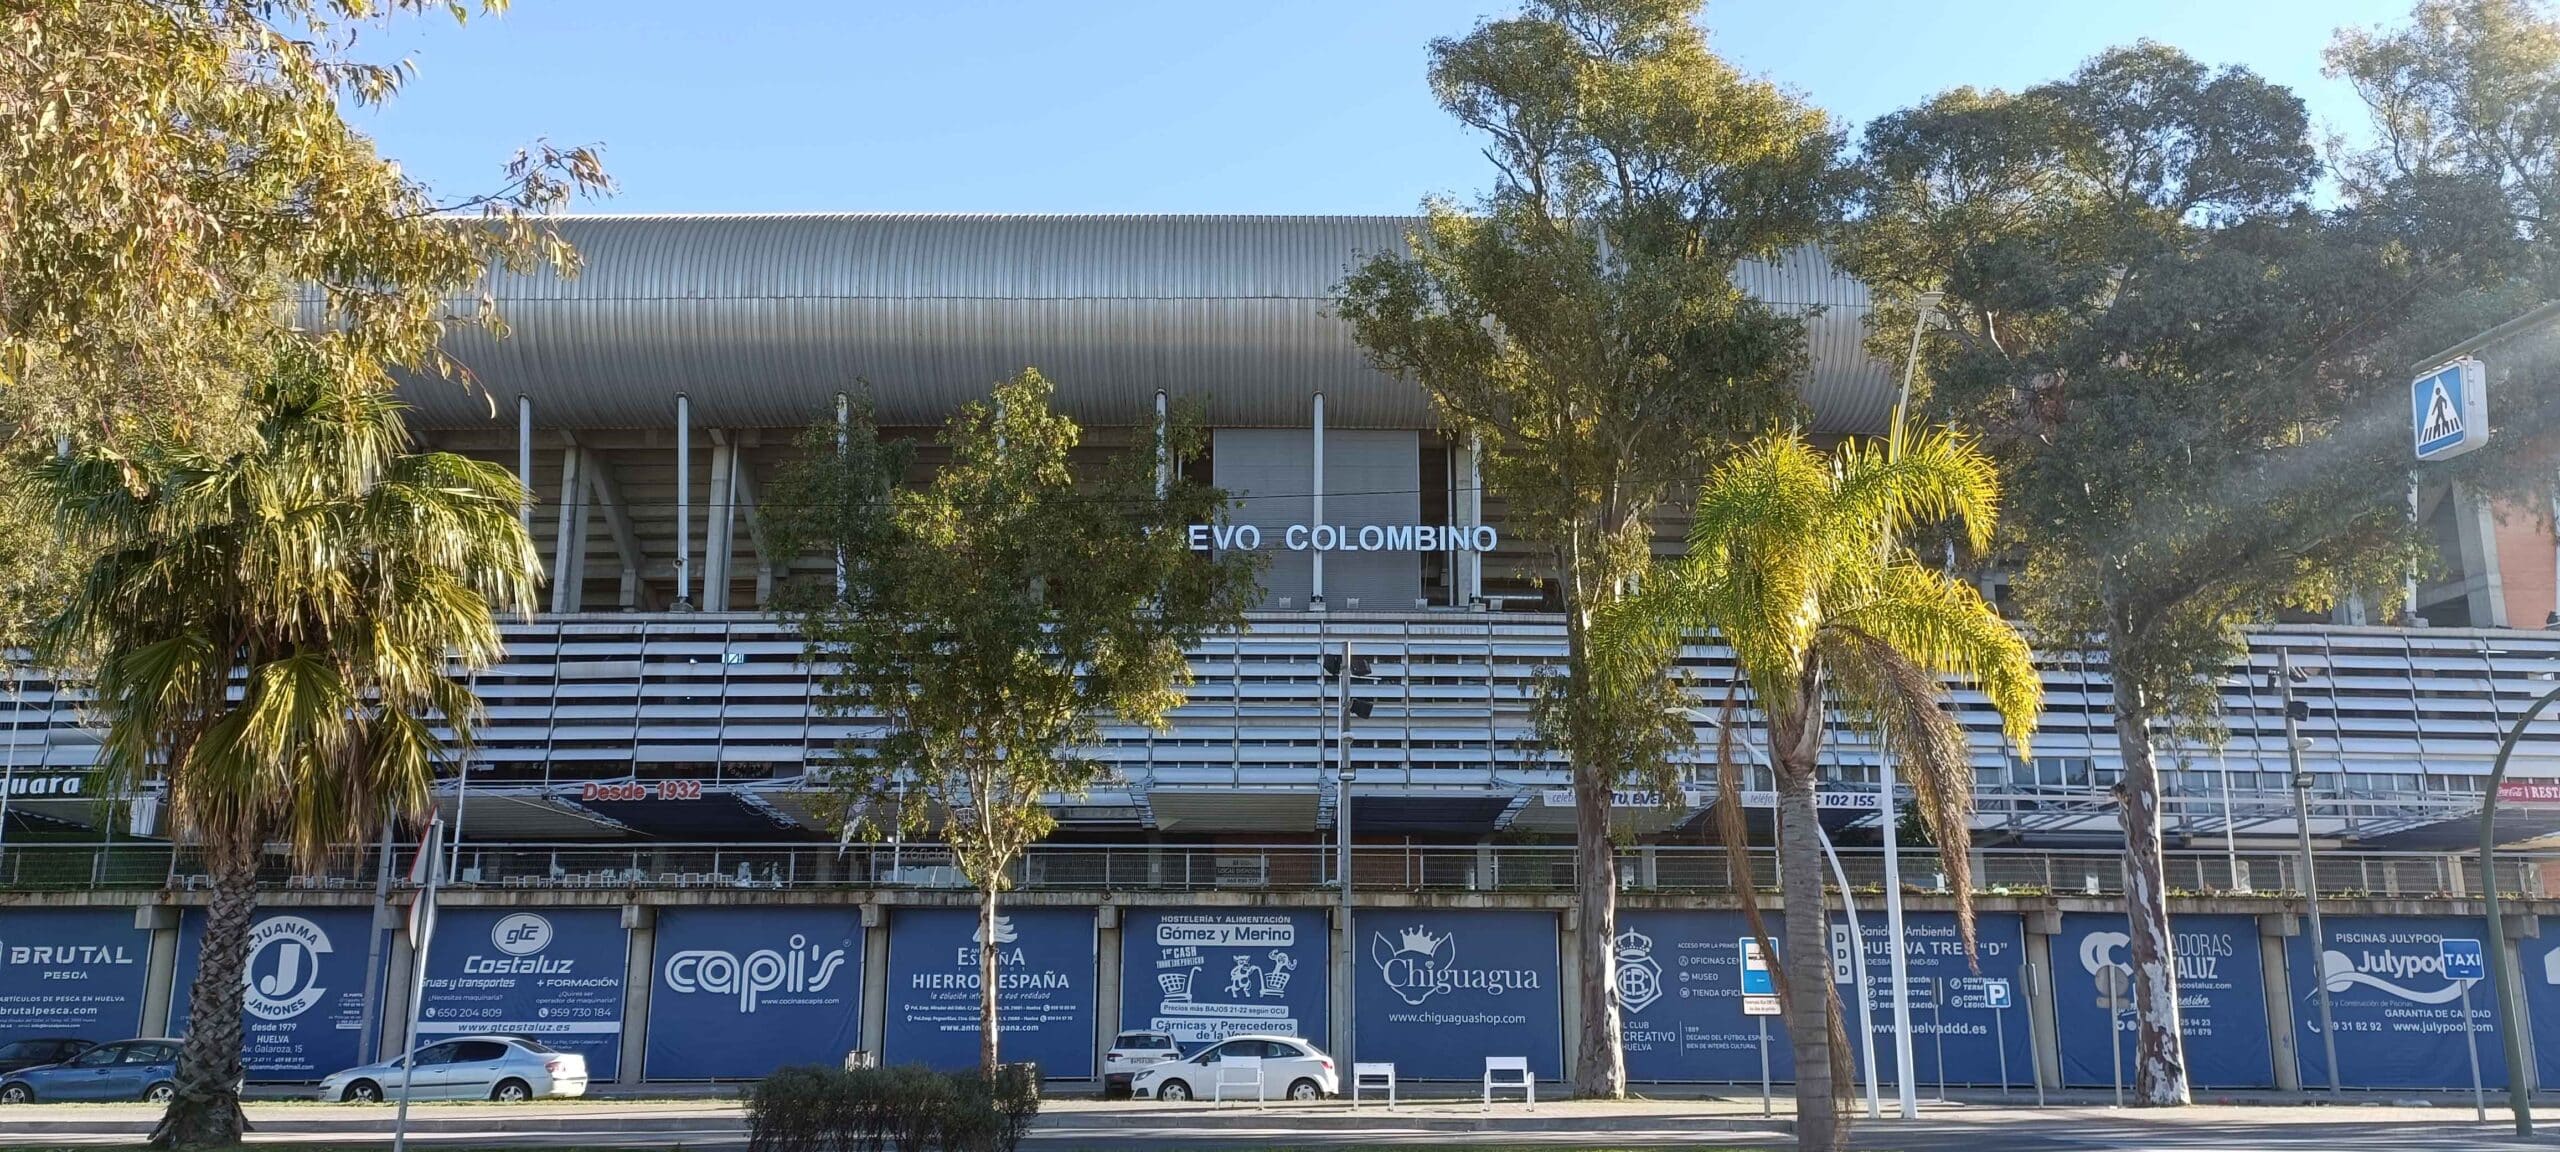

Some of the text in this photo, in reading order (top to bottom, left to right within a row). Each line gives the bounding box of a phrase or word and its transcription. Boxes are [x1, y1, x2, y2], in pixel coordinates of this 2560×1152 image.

[1188, 525, 1497, 551] EVO COLOMBINO
[582, 781, 702, 800] Desde 1932
[2531, 786, 2560, 799] REST
[1632, 793, 1661, 805] EVE
[1825, 795, 1849, 806] 102
[1853, 795, 1876, 807] 155
[1161, 915, 1214, 923] HOSTELERÍA
[1225, 915, 1291, 923] ALIMENTACIÓN
[1160, 926, 1291, 943] Gómez y Merino
[1905, 924, 1956, 937] Ambiental
[2335, 933, 2387, 943] PISCINAS
[1863, 941, 1926, 955] HUEVA
[1930, 941, 1964, 955] TRE
[2171, 933, 2233, 957] ADORAS
[11, 946, 133, 964] BRUTAL
[1173, 946, 1197, 959] CASH
[463, 955, 575, 974] Costaluz
[1690, 957, 1725, 965] OFICINAS
[2444, 953, 2481, 967] TAXI
[43, 971, 88, 980] PESCA
[665, 933, 845, 1013] capi's
[1383, 958, 1541, 995] Chiguagua
[1692, 973, 1719, 981] MUSEO
[449, 979, 458, 991] y
[458, 978, 516, 991] transportes
[546, 977, 619, 988] FORMACIÓN
[912, 971, 1070, 989] HIERRO ESPAÑA
[1693, 989, 1741, 997] TIENDA OFICI
[1989, 984, 2006, 1005] P
[248, 998, 307, 1016] JAMONES
[761, 997, 840, 1006] www.cocinascapis.com
[437, 1008, 502, 1018] 650 204 809
[550, 1008, 612, 1017] 959 730 184
[2385, 1009, 2433, 1018] GARANTIA
[2435, 1009, 2448, 1018] DE
[1389, 1012, 1526, 1026] www.chiguaguashop.com
[2202, 1018, 2211, 1026] 23
[251, 1023, 297, 1031] desde 1979
[1156, 1020, 1293, 1032] Cárnicas y Perecederos
[1629, 1021, 1650, 1029] CLUB
[2342, 1022, 2353, 1031] 31
[2356, 1022, 2368, 1031] 82
[2370, 1022, 2382, 1031] 92
[256, 1035, 290, 1044] HUELVA
[1196, 1031, 1210, 1040] de
[1214, 1031, 1224, 1040] la
[1622, 1031, 1676, 1042] CREATIVO
[1723, 1033, 1747, 1041] FÚTBOL
[295, 1044, 303, 1053] 15
[1708, 1042, 1730, 1050] INTERÉS
